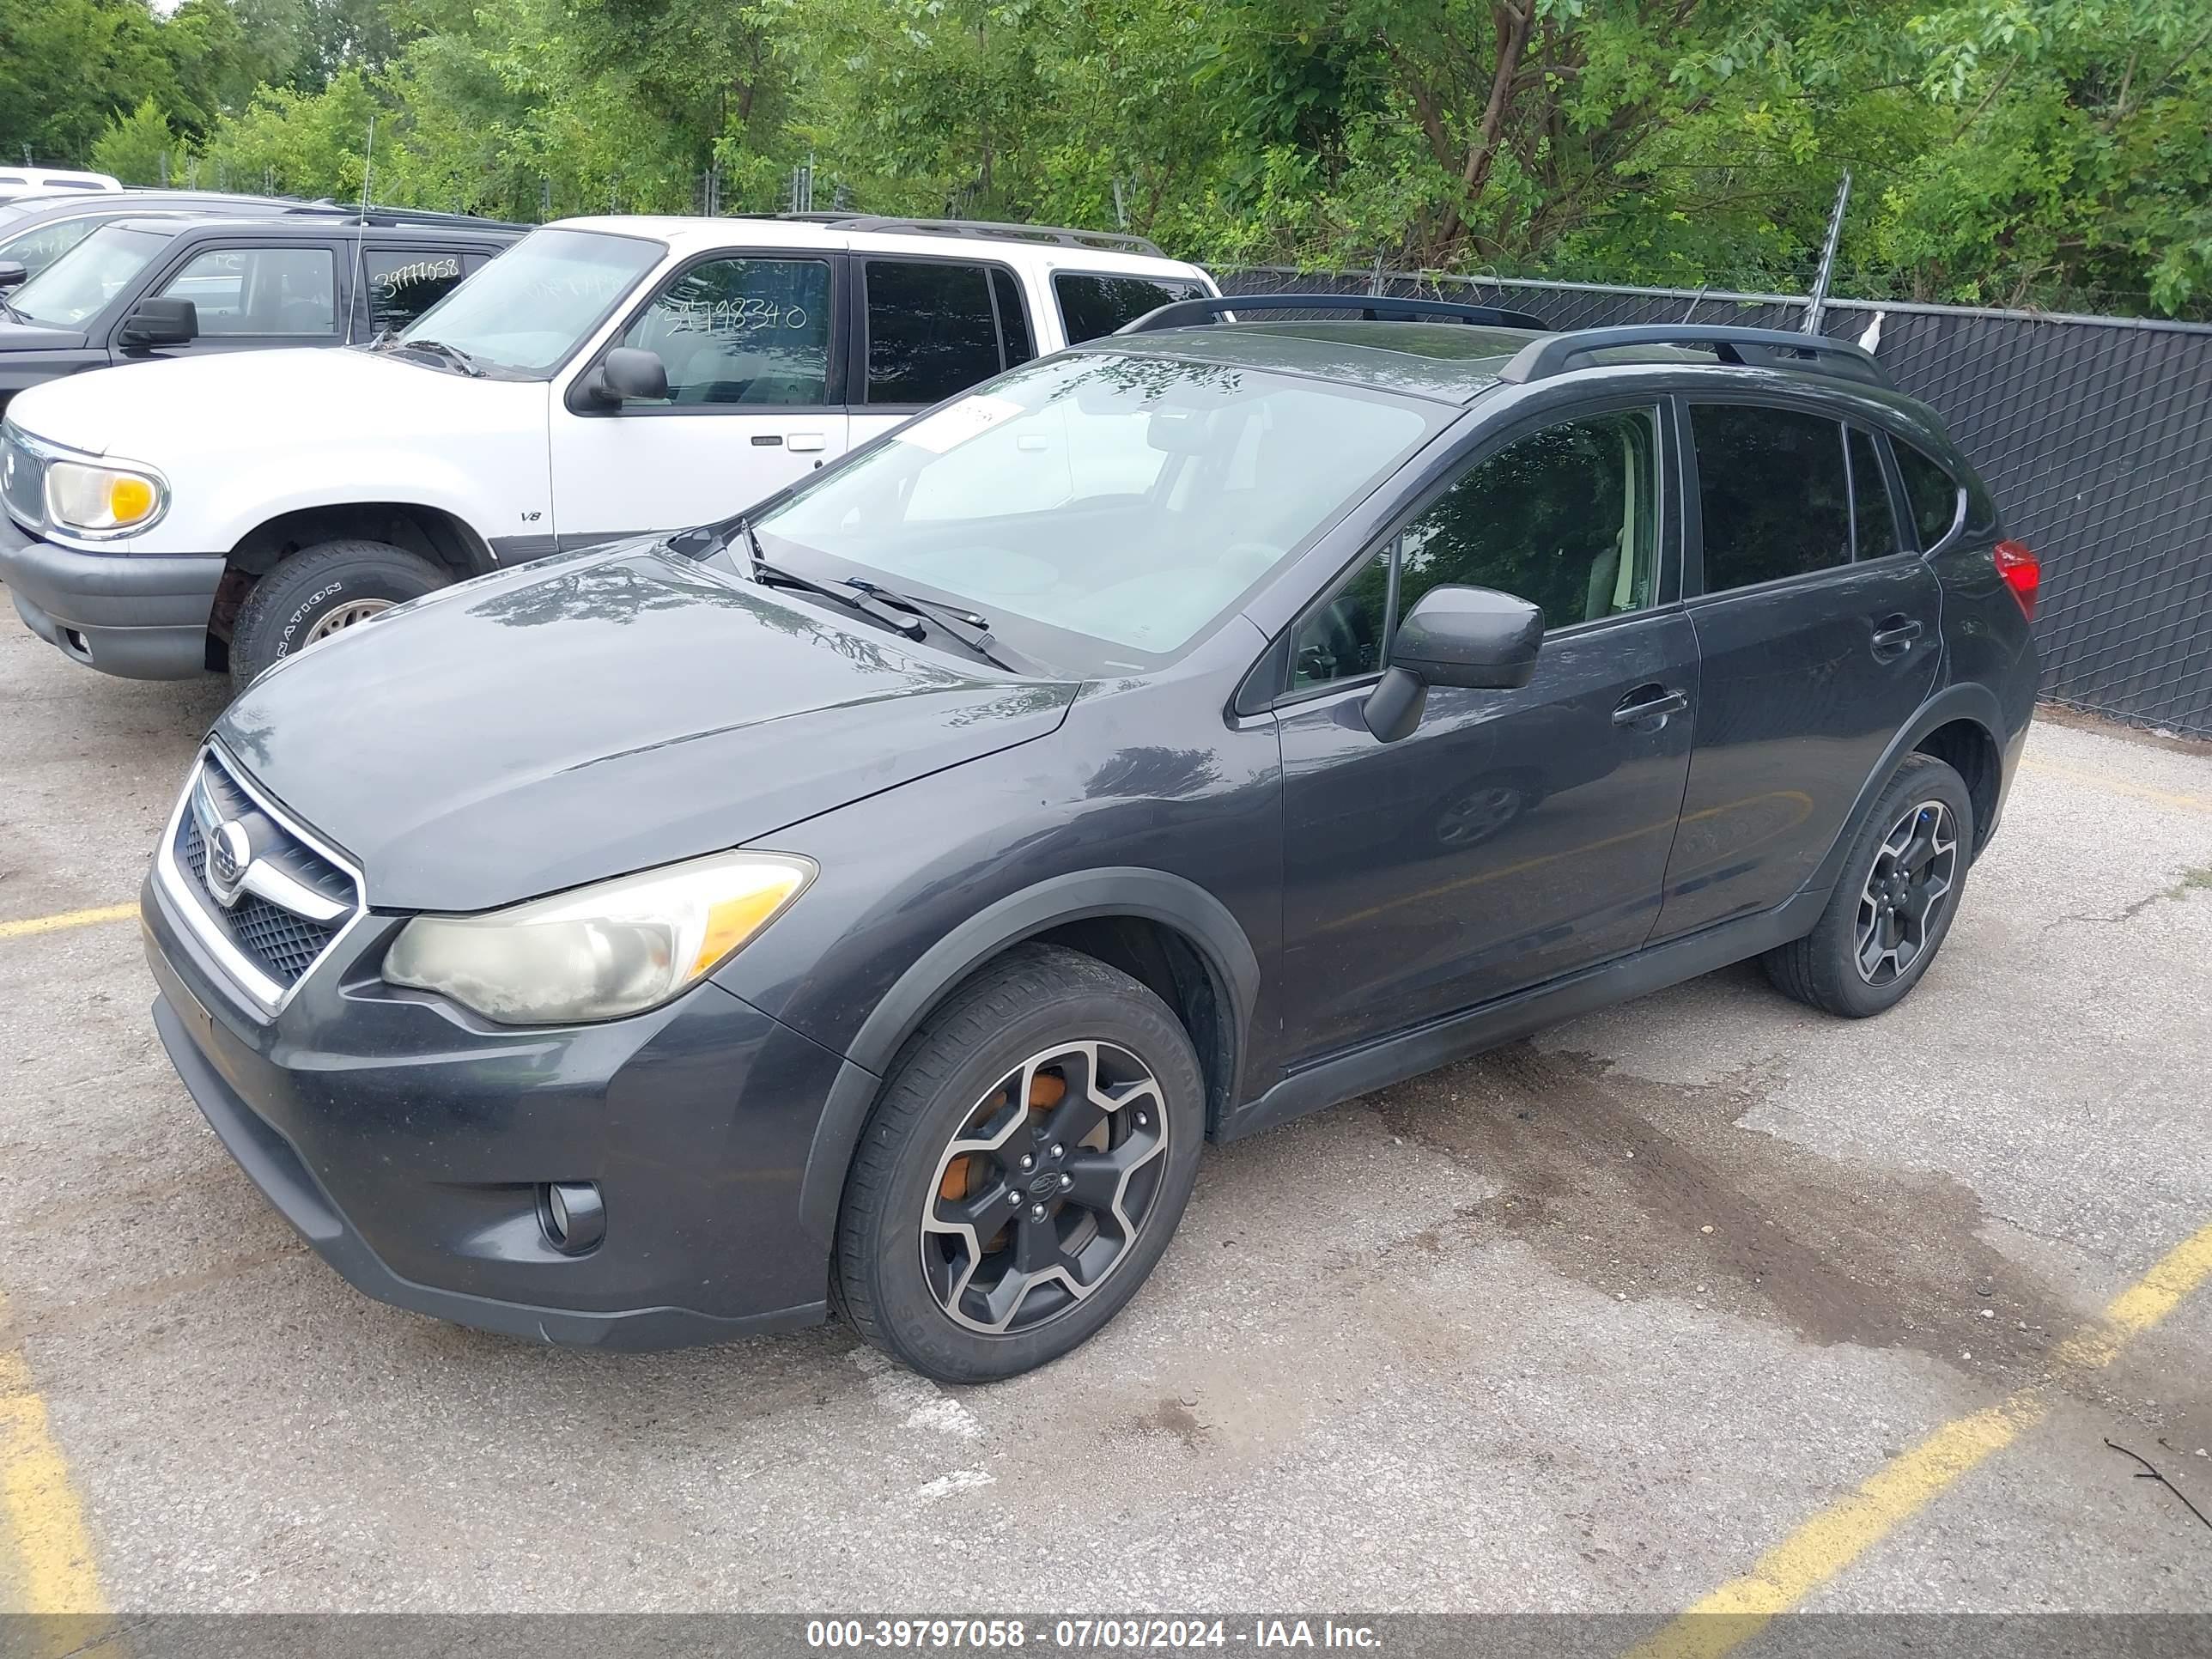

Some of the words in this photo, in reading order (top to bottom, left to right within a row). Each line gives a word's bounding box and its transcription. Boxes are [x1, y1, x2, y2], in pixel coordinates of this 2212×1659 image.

[374, 258, 459, 299] 39777058
[657, 297, 807, 337] 39798340
[520, 512, 542, 521] V8
[276, 581, 343, 659] NATION
